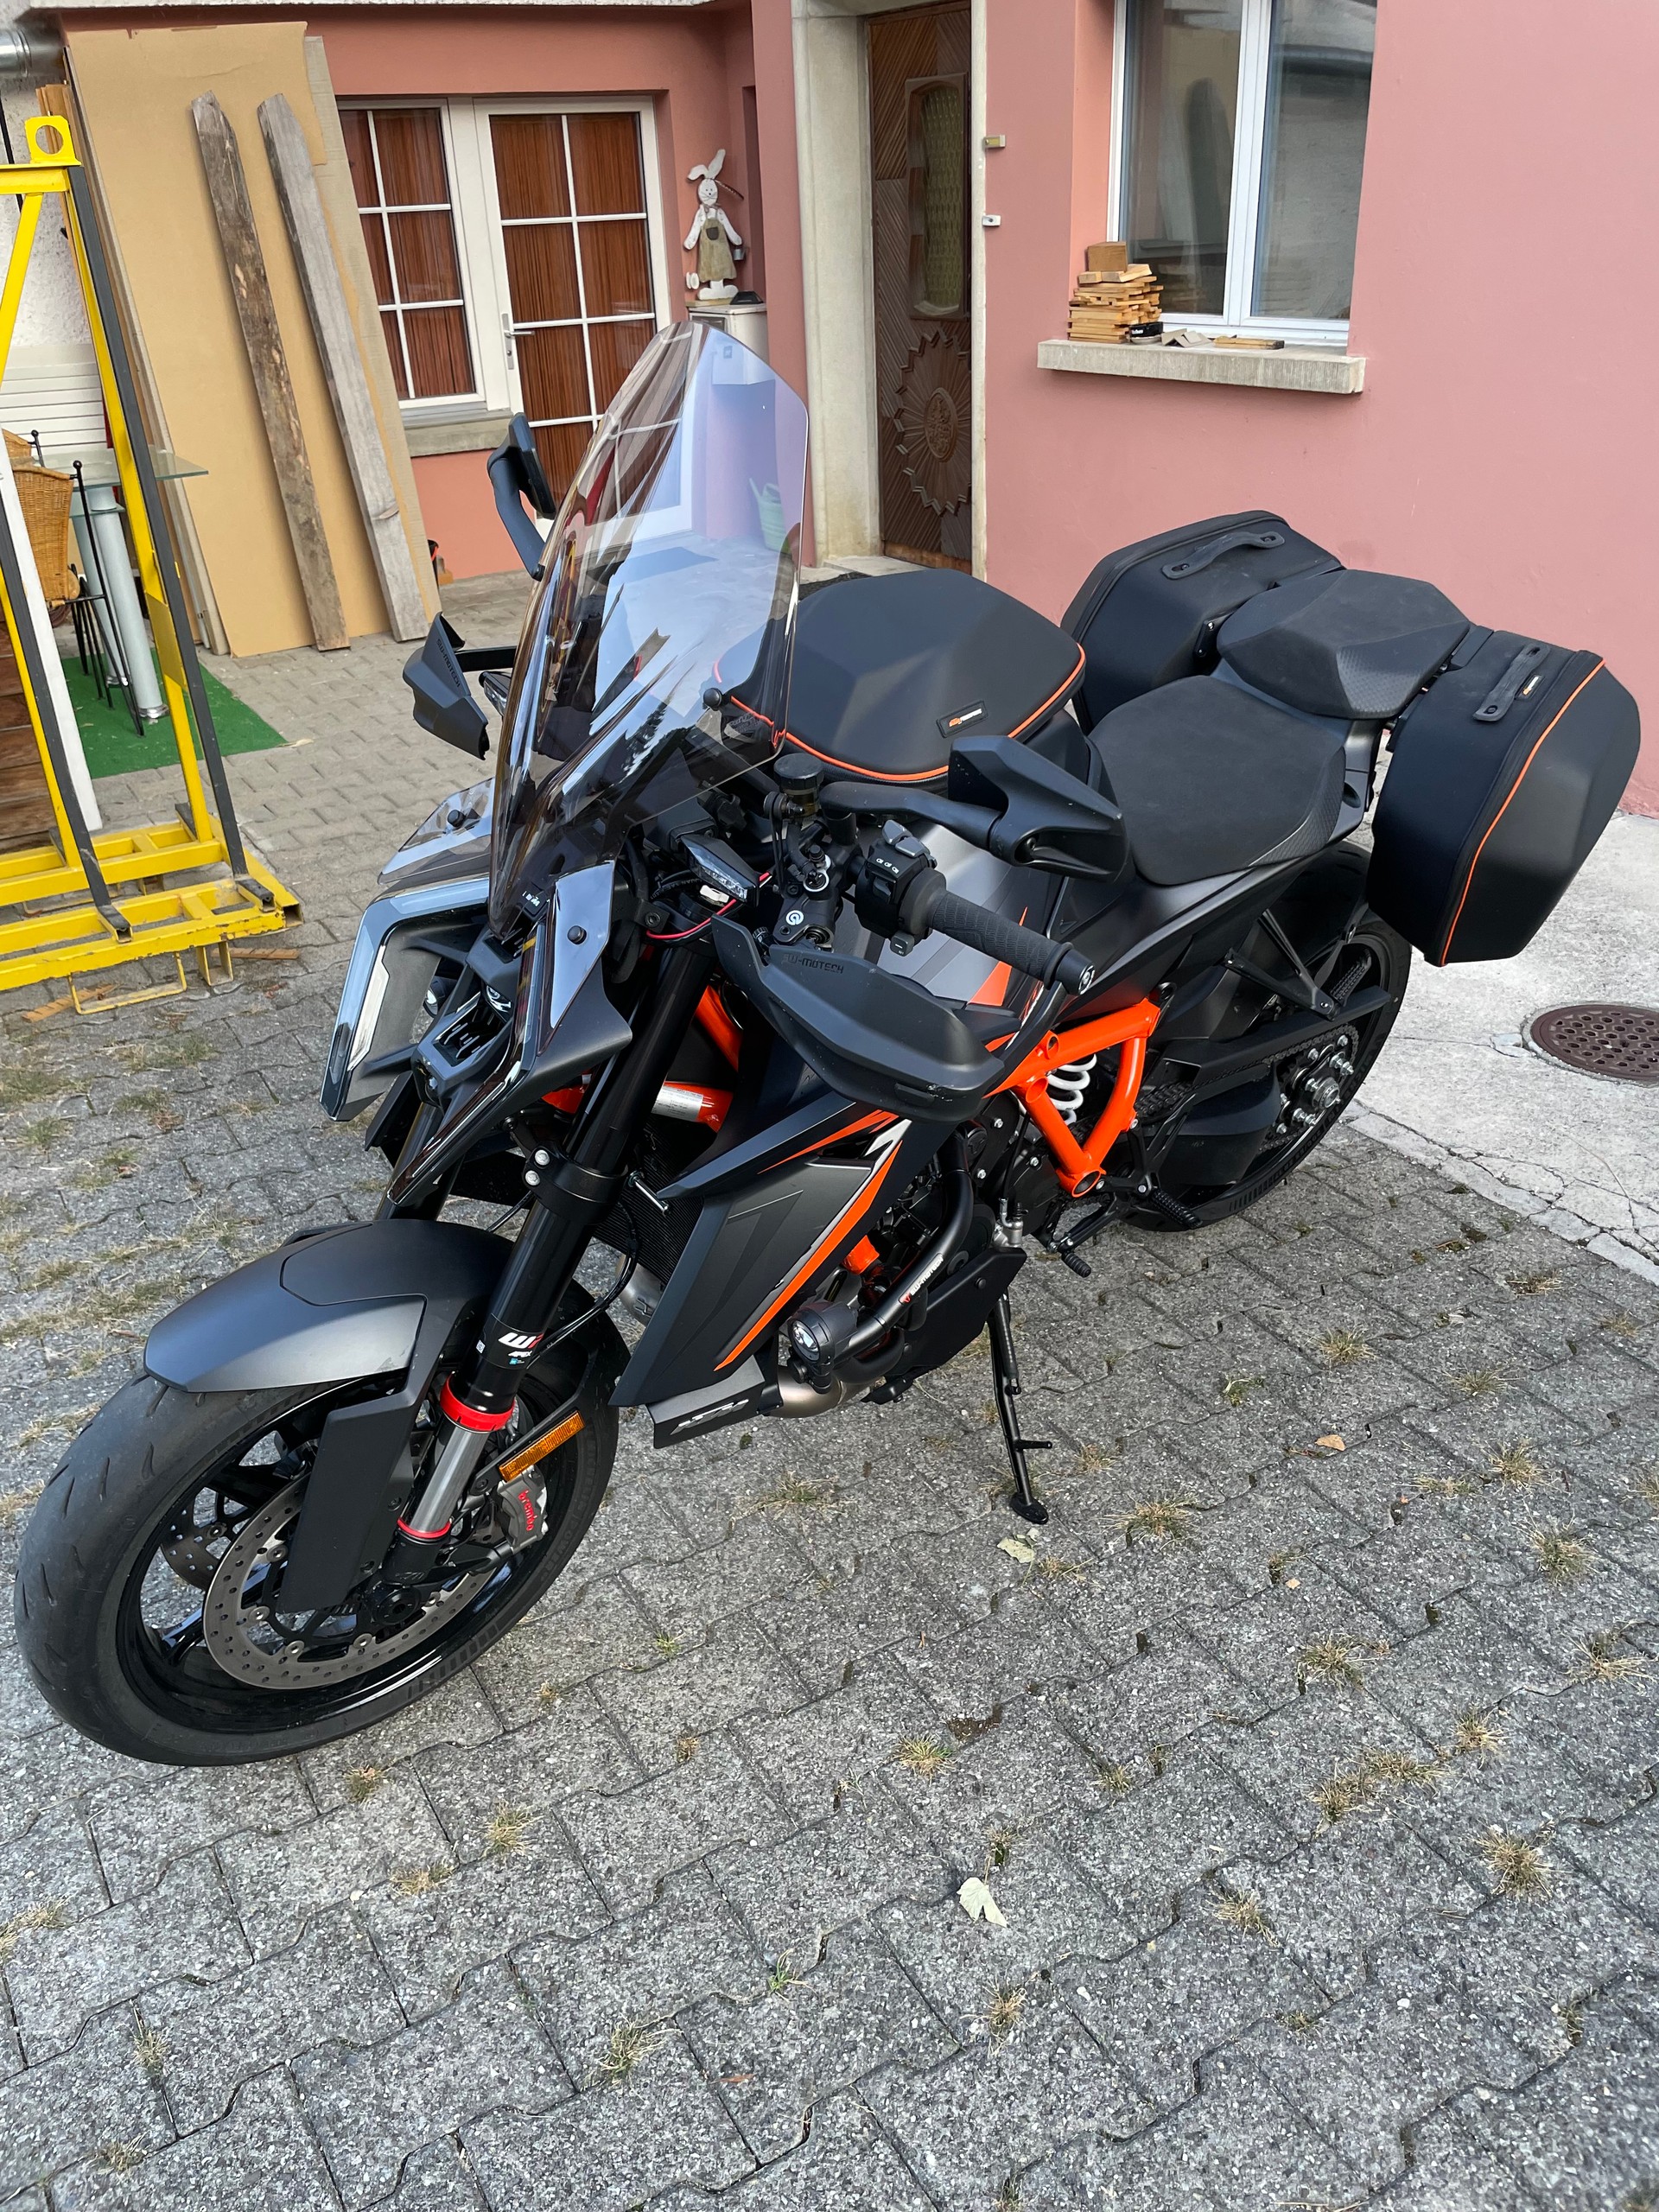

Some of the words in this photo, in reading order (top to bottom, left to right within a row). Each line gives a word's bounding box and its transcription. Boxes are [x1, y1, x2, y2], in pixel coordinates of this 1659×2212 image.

[436, 638, 461, 687] SW-MOTECH
[781, 953, 844, 974] SW-MOTECH
[910, 1255, 944, 1296] SW-MOTECH
[518, 1489, 538, 1532] brembo
